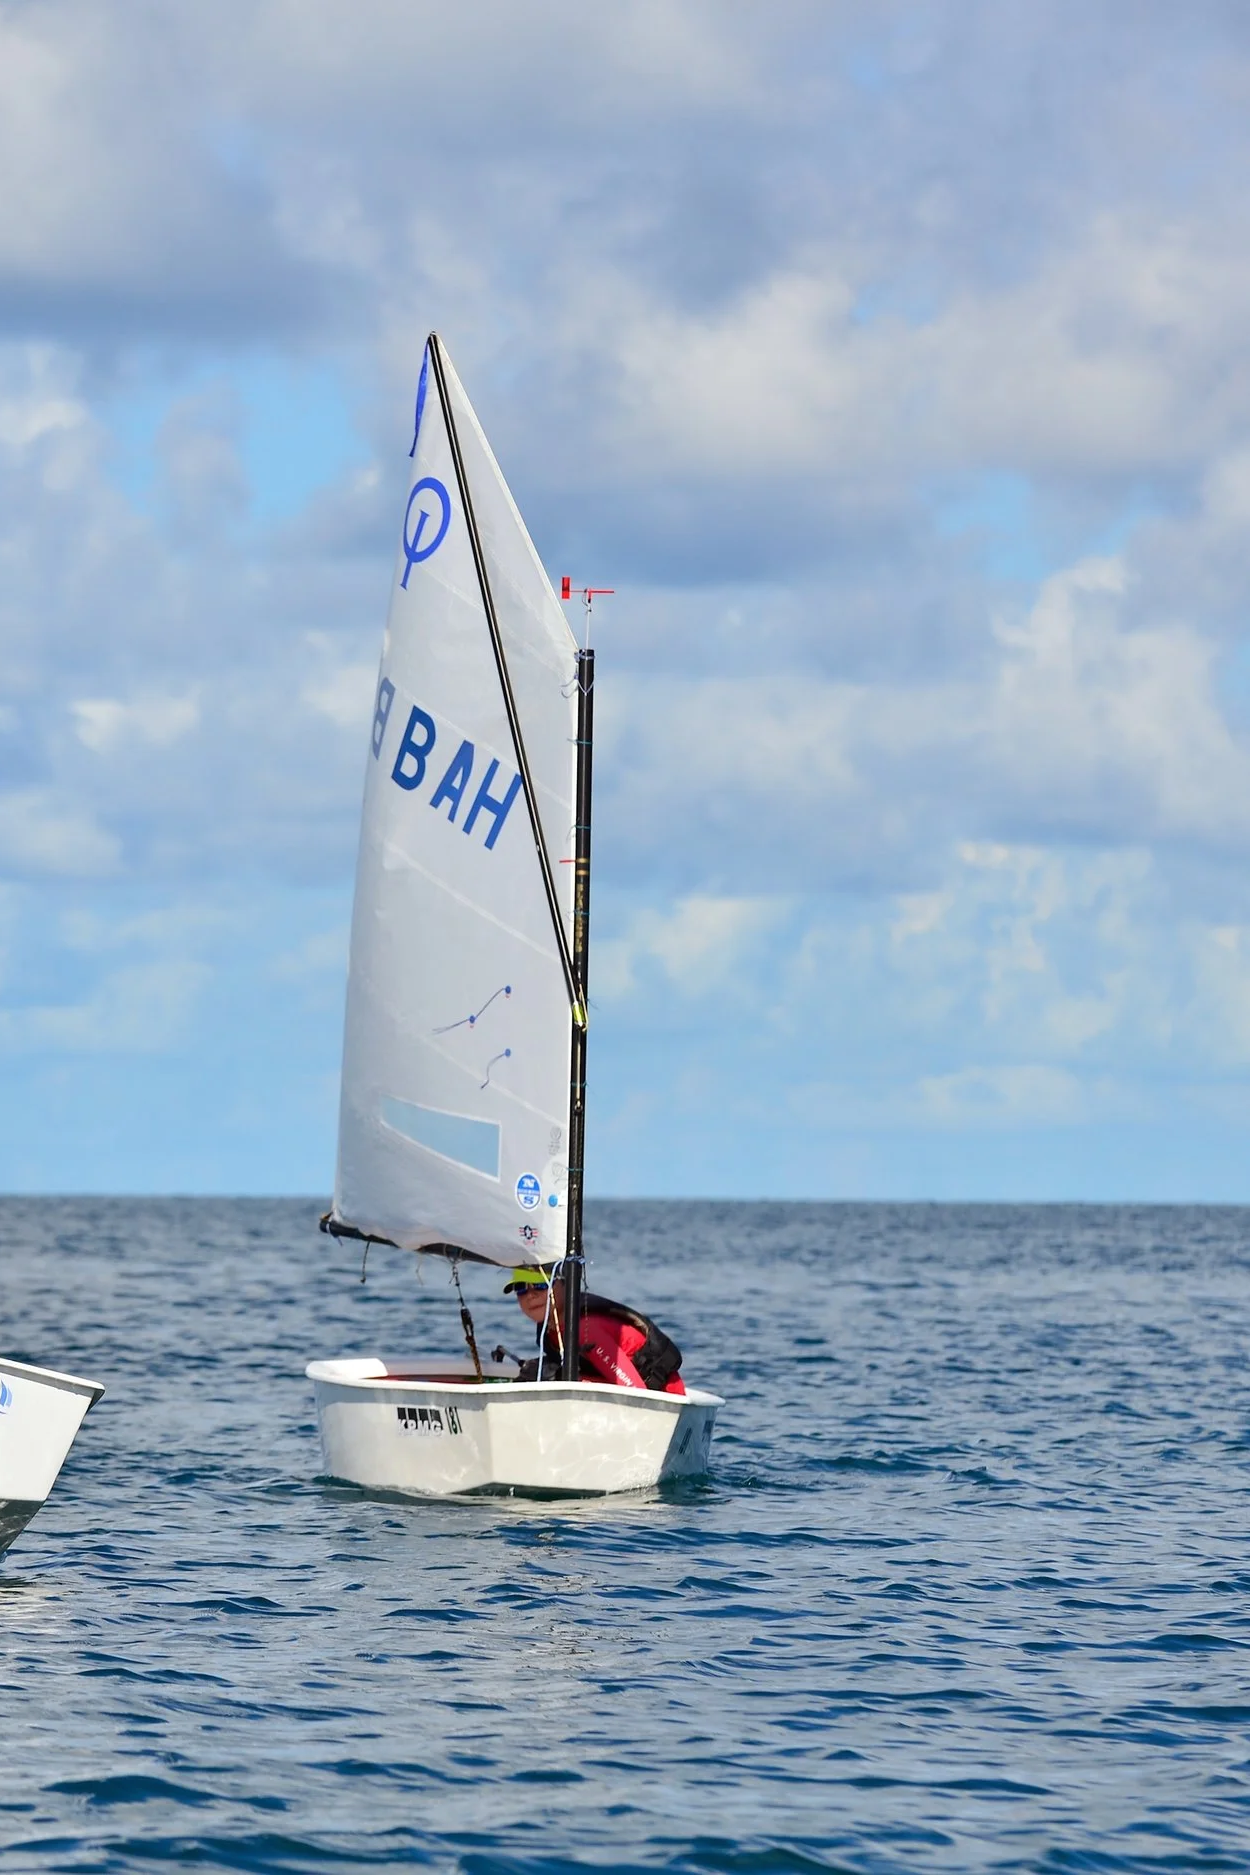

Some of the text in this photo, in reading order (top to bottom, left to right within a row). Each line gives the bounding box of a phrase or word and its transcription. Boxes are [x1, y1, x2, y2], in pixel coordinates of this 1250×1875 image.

[391, 705, 524, 850] BAH
[610, 1362, 633, 1387] VIRGIN
[397, 1418, 443, 1437] KPMG
